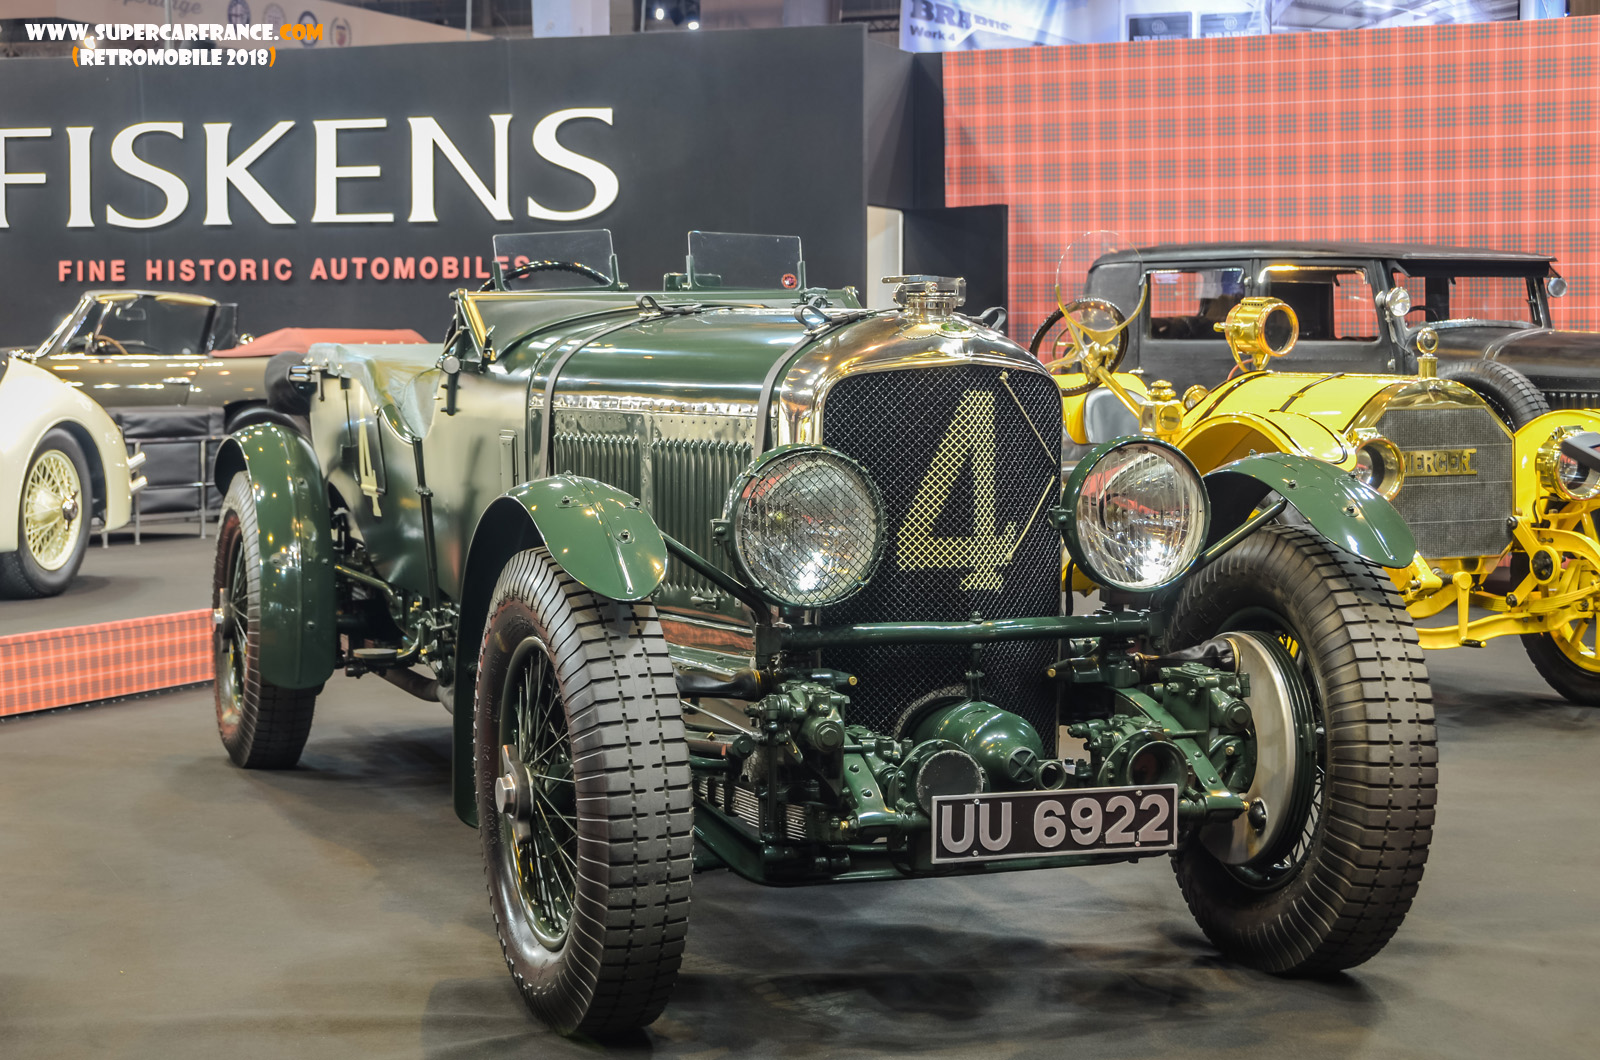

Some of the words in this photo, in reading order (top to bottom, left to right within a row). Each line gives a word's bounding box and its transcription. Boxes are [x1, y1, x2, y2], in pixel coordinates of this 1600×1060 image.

[0, 108, 619, 228] FISKENS
[58, 259, 126, 282] FINE
[146, 258, 293, 282] HISTORIC
[896, 390, 1016, 592] 4
[941, 802, 1012, 853] UU
[1034, 794, 1170, 848] 6922
